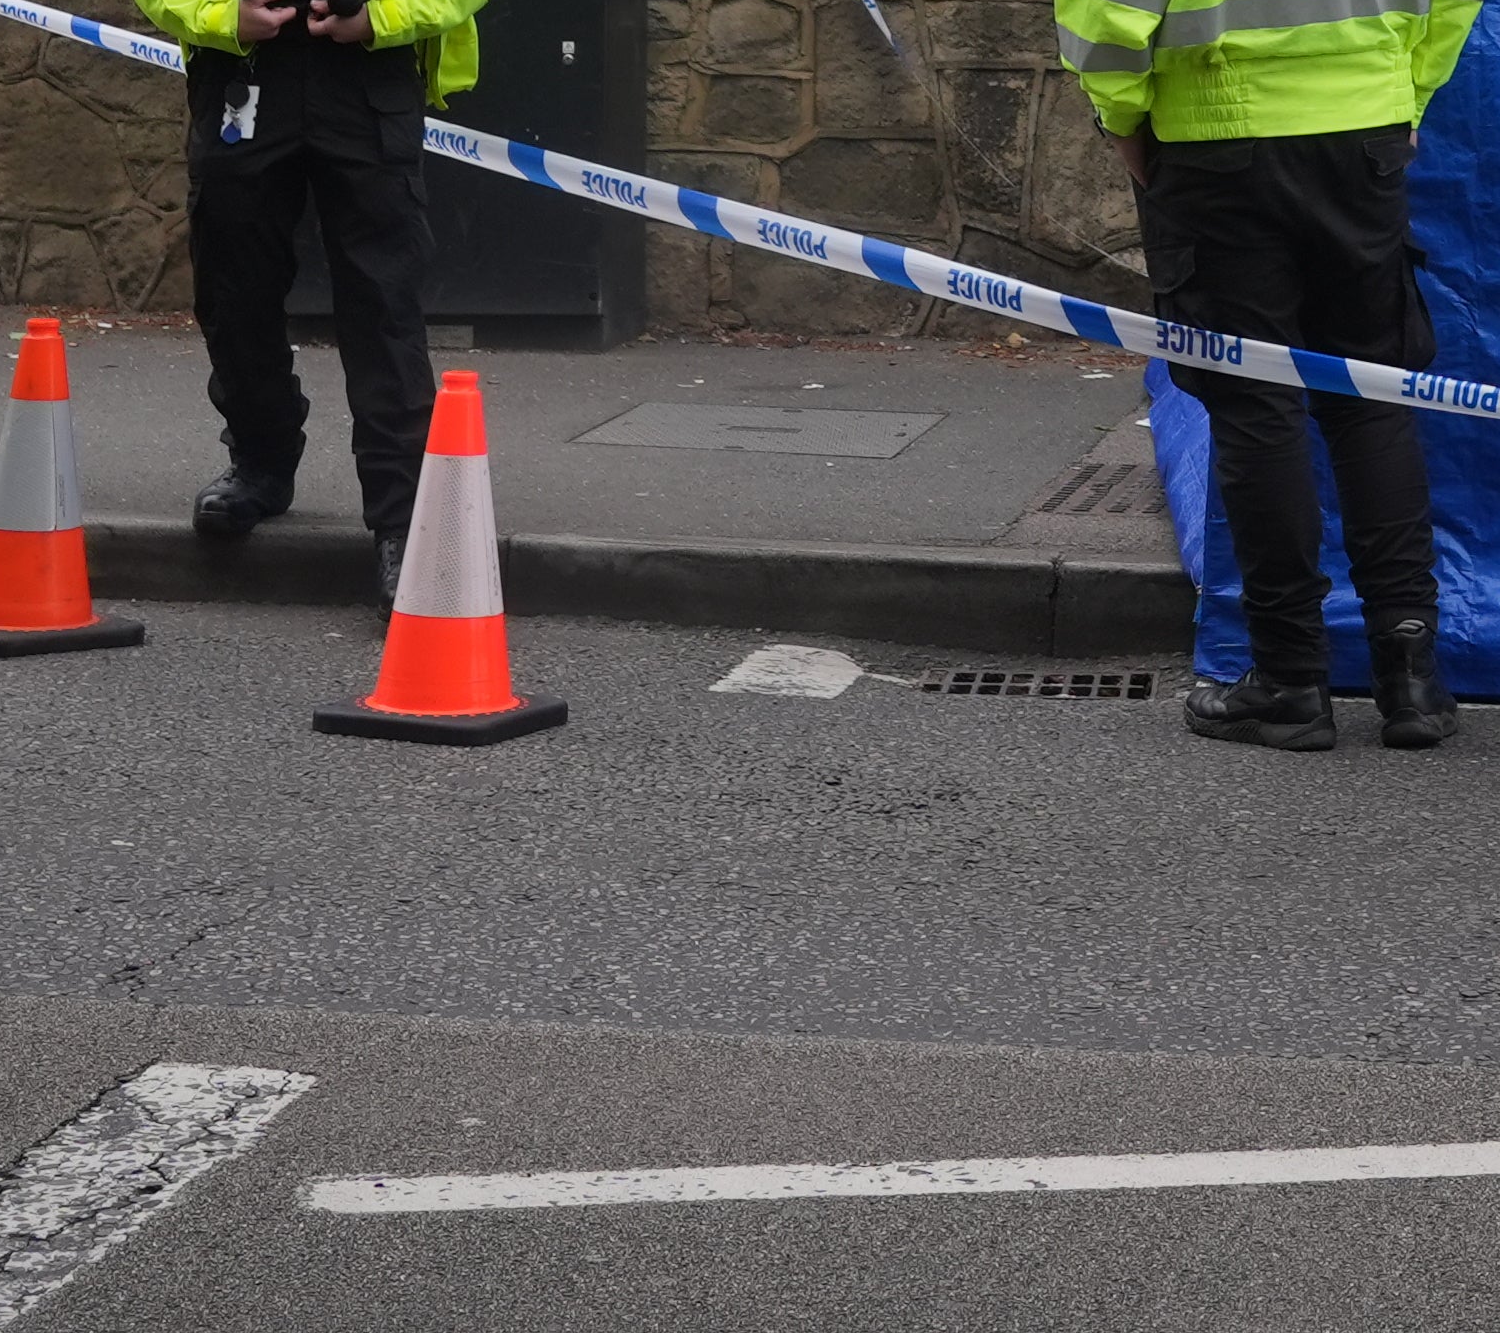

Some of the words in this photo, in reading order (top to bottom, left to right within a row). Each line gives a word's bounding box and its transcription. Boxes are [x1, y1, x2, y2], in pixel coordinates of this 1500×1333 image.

[582, 170, 649, 210] POLICE
[757, 217, 828, 260] POLICE
[947, 268, 1023, 313] POLICE
[1156, 320, 1243, 365] POLICE
[1401, 371, 1500, 413] POLICE
